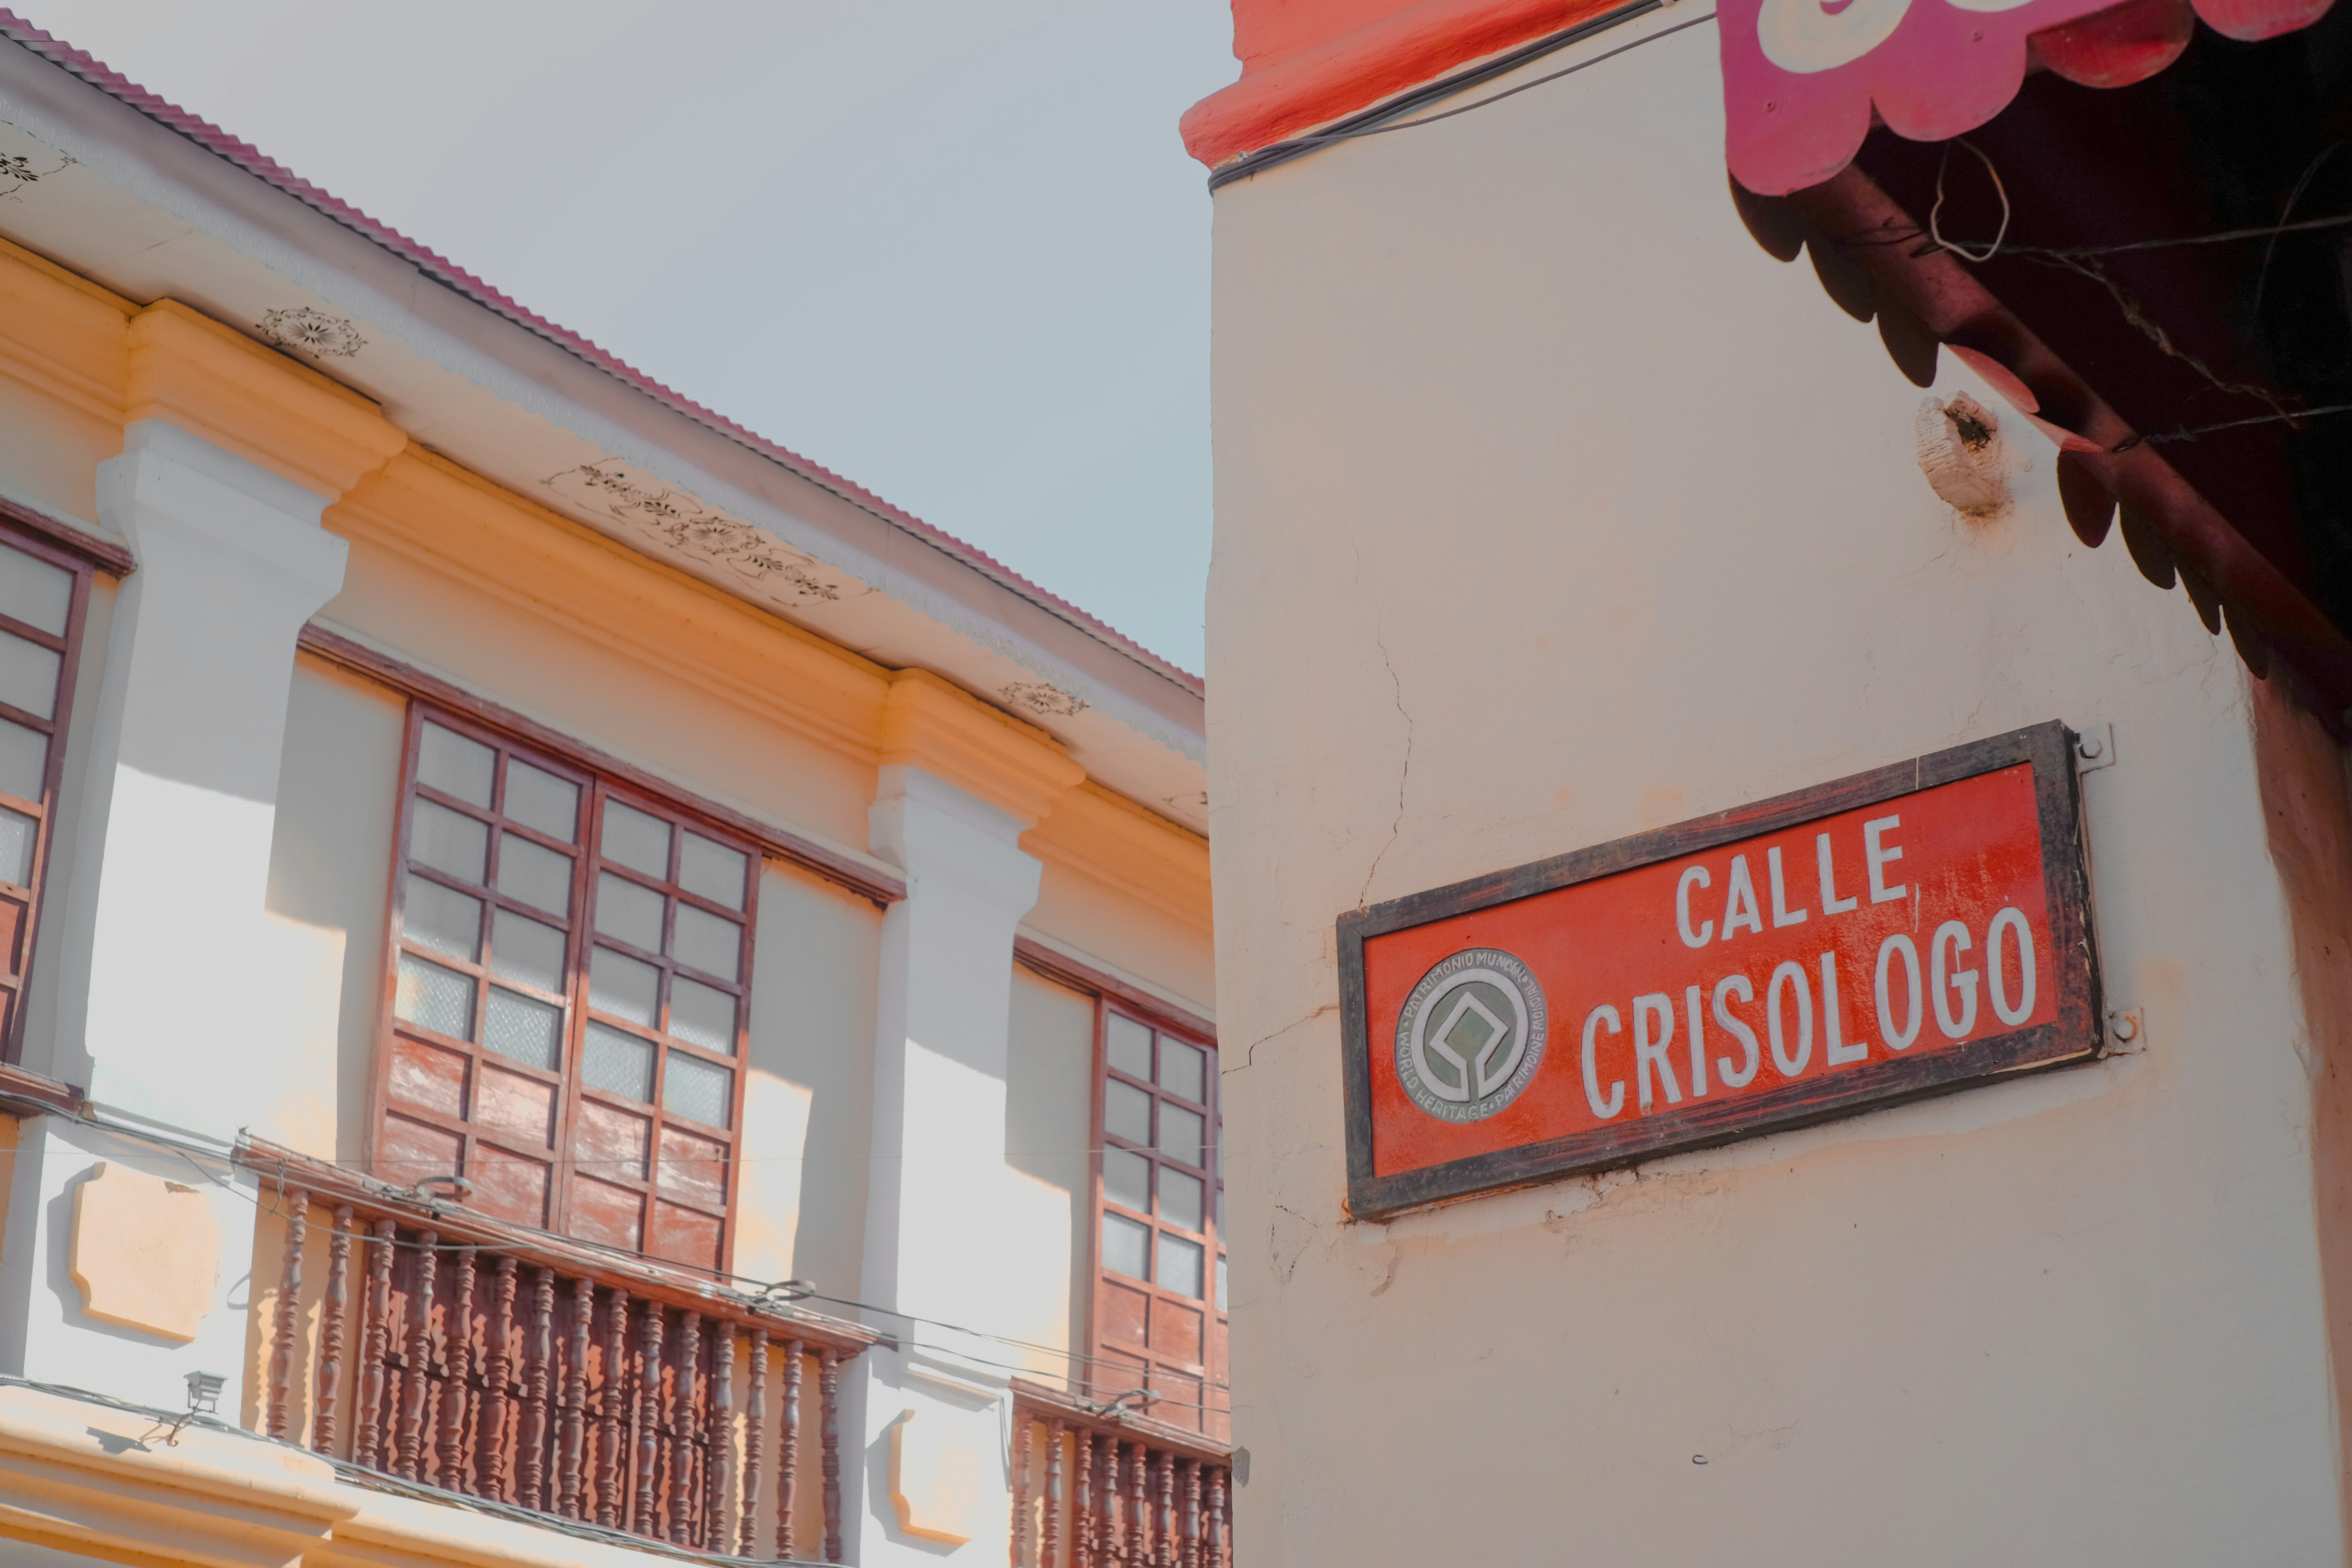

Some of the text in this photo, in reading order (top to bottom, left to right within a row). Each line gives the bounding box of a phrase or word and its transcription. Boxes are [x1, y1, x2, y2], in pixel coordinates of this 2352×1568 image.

[1676, 814, 1907, 948] CALLE
[1404, 951, 1526, 1017] PATRIMONIO MUNDIAL
[1494, 979, 1544, 1107] PATRIMOINE MONDIAL
[1581, 906, 2036, 1119] CRISOLOGO
[1397, 1031, 1489, 1120] WORLD HERITAGE
